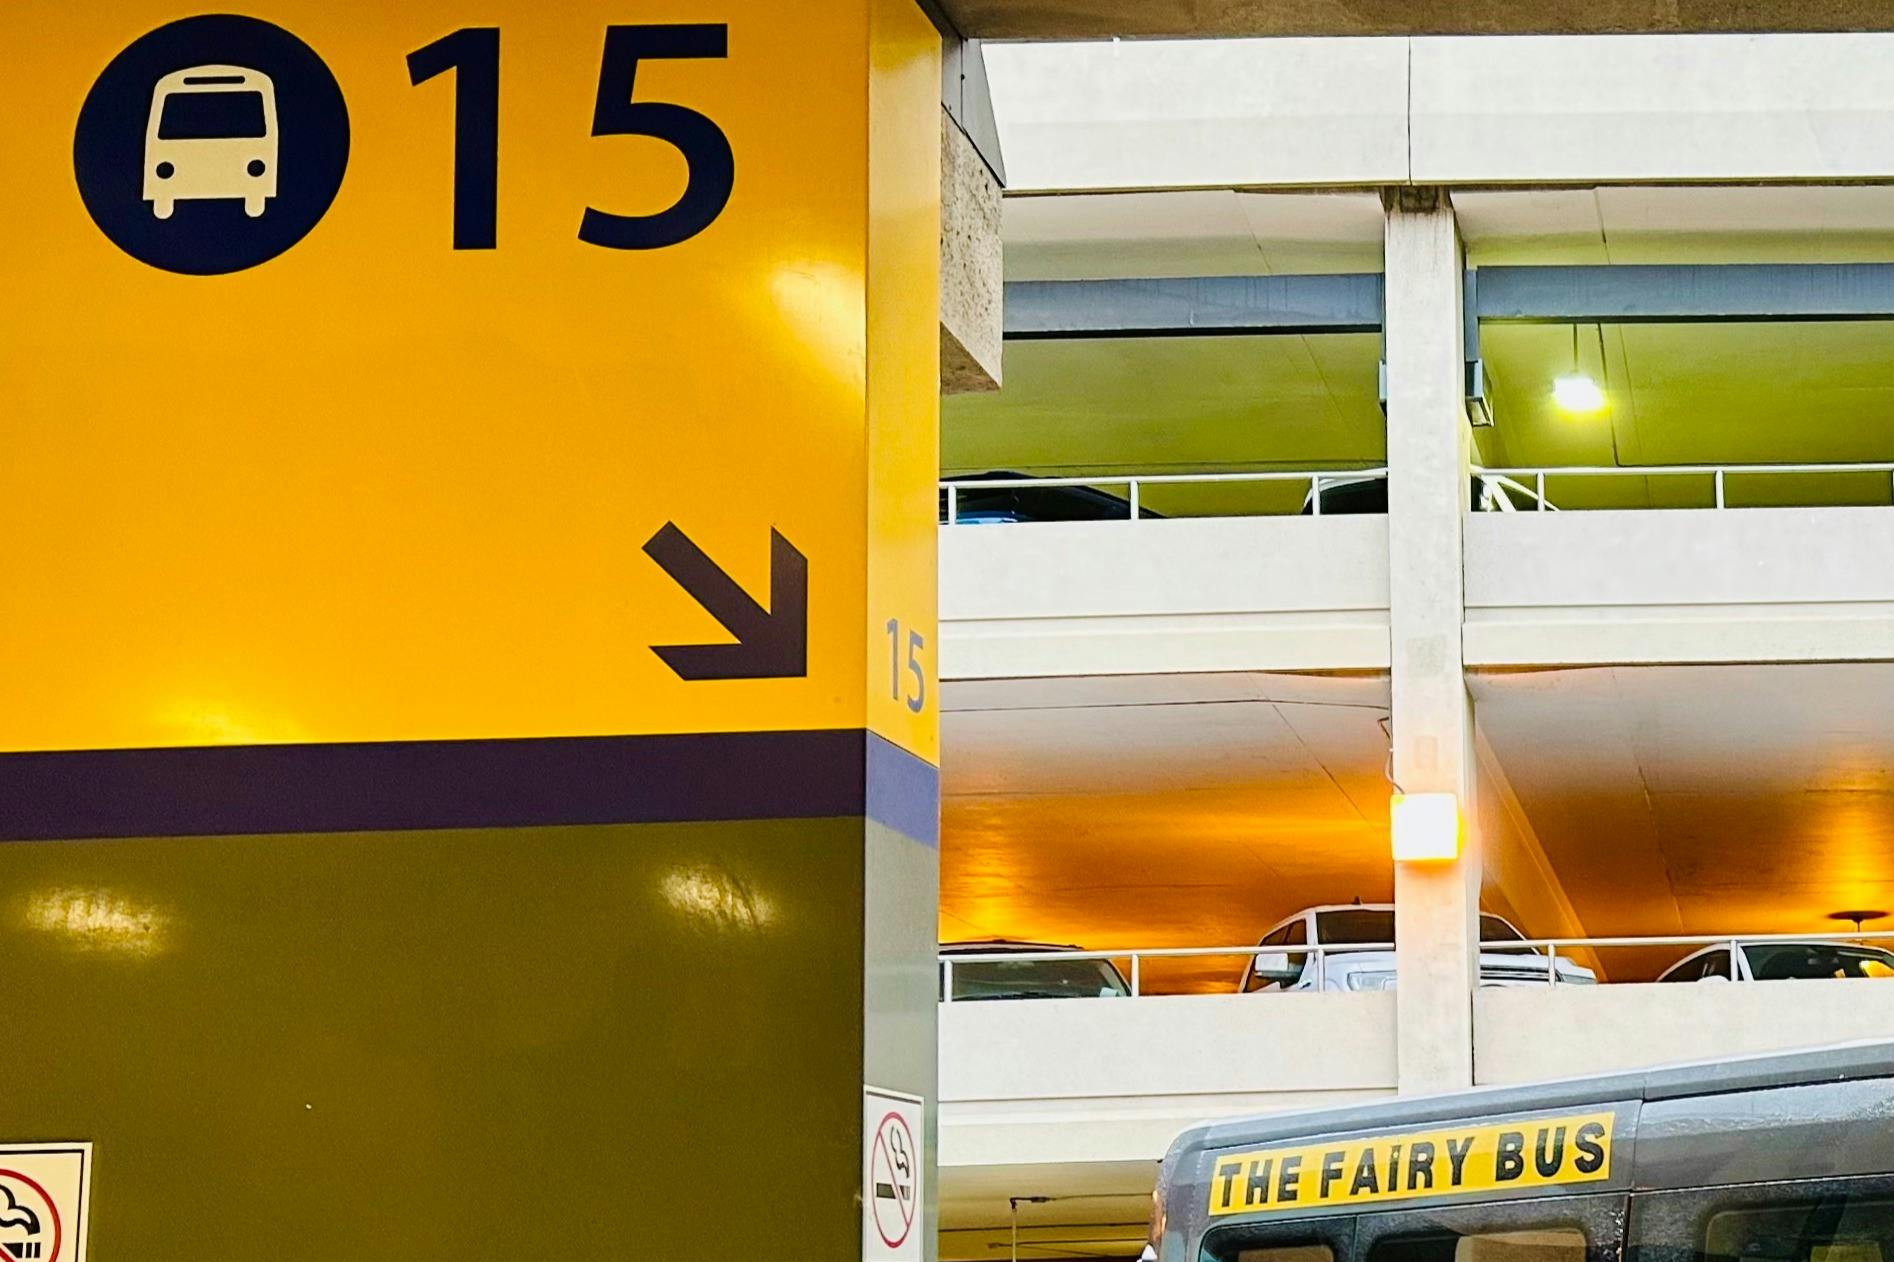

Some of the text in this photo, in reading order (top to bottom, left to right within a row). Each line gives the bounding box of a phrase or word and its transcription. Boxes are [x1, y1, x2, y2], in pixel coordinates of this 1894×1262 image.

[406, 23, 735, 251] 15
[886, 618, 925, 713] 15
[1218, 1121, 1606, 1208] THE FAIRY BUS
